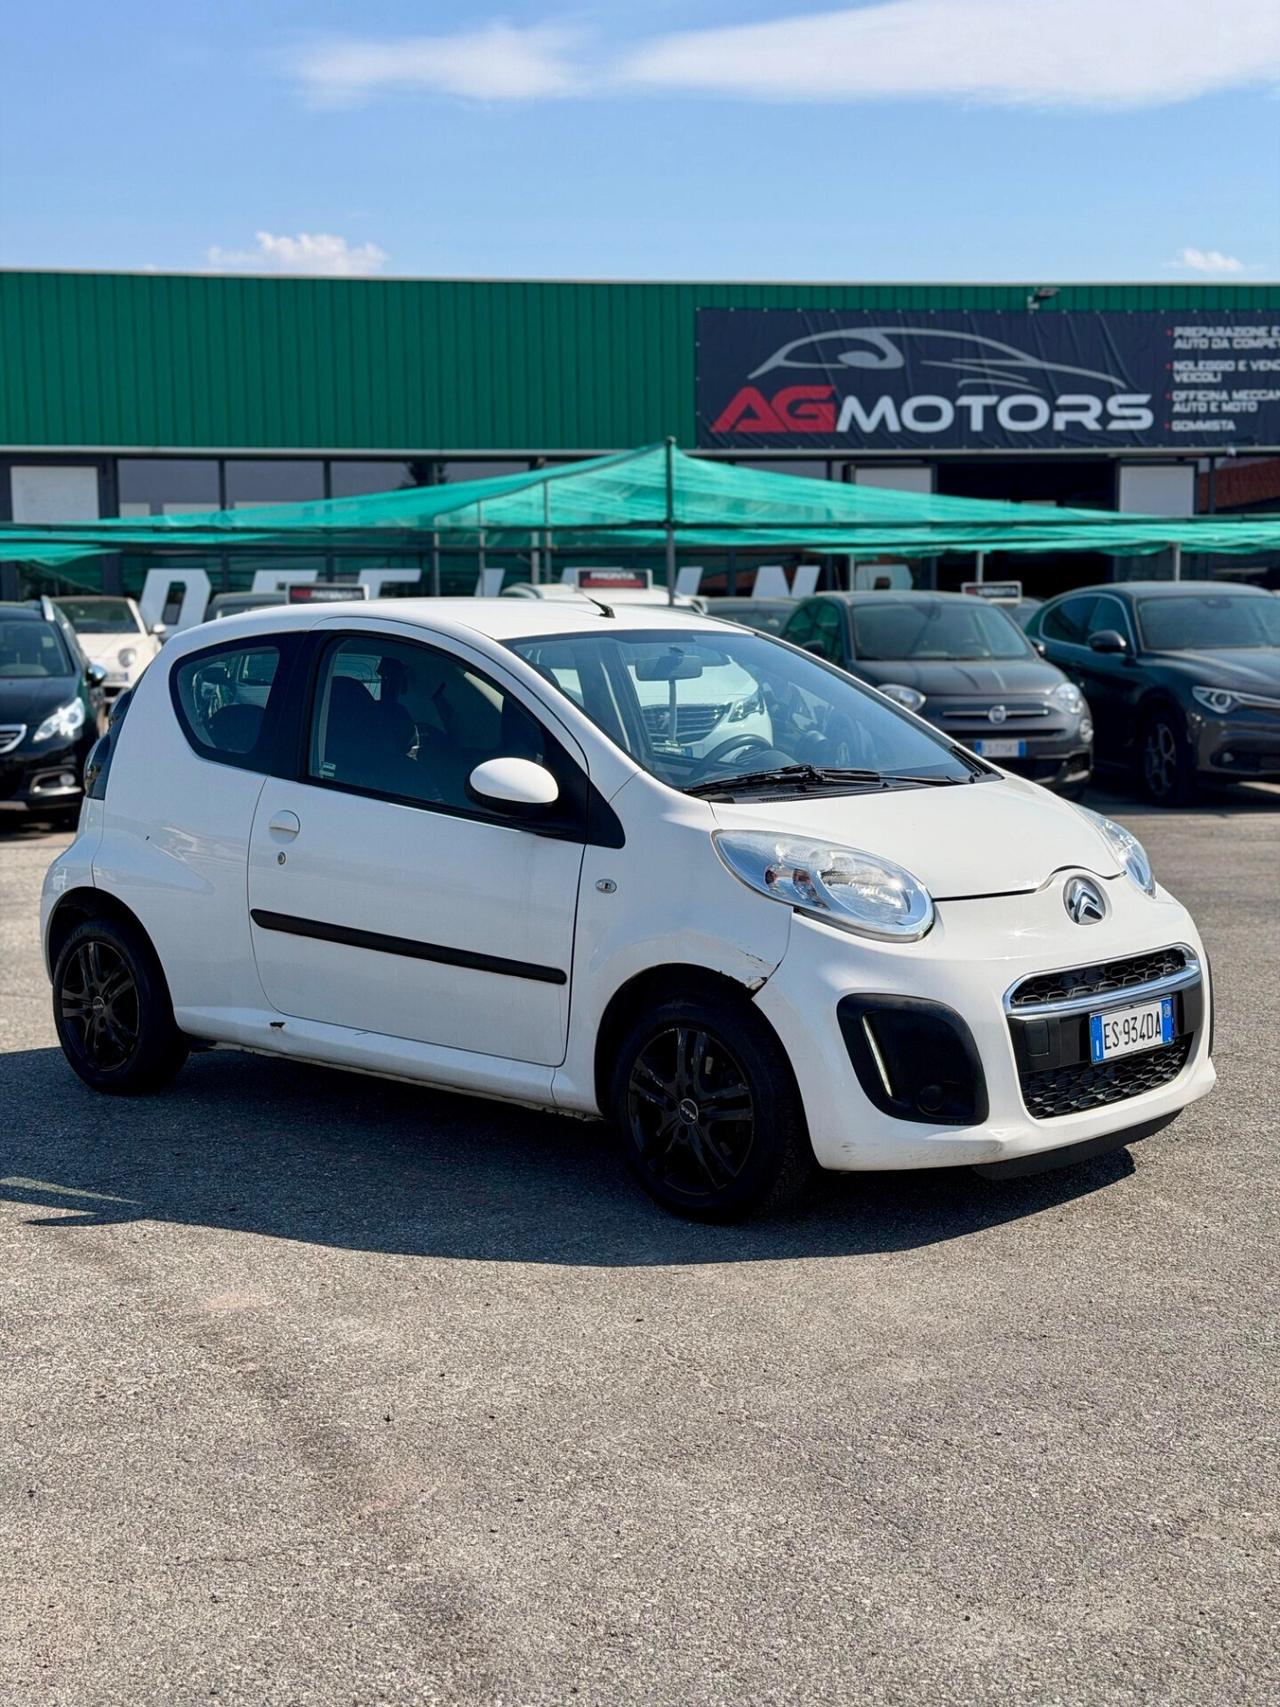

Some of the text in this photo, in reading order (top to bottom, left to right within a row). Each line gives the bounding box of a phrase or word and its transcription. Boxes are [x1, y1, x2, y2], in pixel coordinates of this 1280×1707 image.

[1174, 326, 1269, 338] PREPARAZIONE
[1174, 338, 1209, 349] AUTO
[1211, 338, 1230, 349] DA
[1173, 360, 1236, 371] NOLEGGIO
[1238, 360, 1247, 371] E
[1173, 372, 1222, 383] VEICOLI
[1172, 390, 1229, 401] OFFICINA
[1172, 401, 1258, 412] AUTO E MOTO
[1171, 420, 1236, 431] GOMMISTA
[1103, 1011, 1162, 1050] ES 934DA
